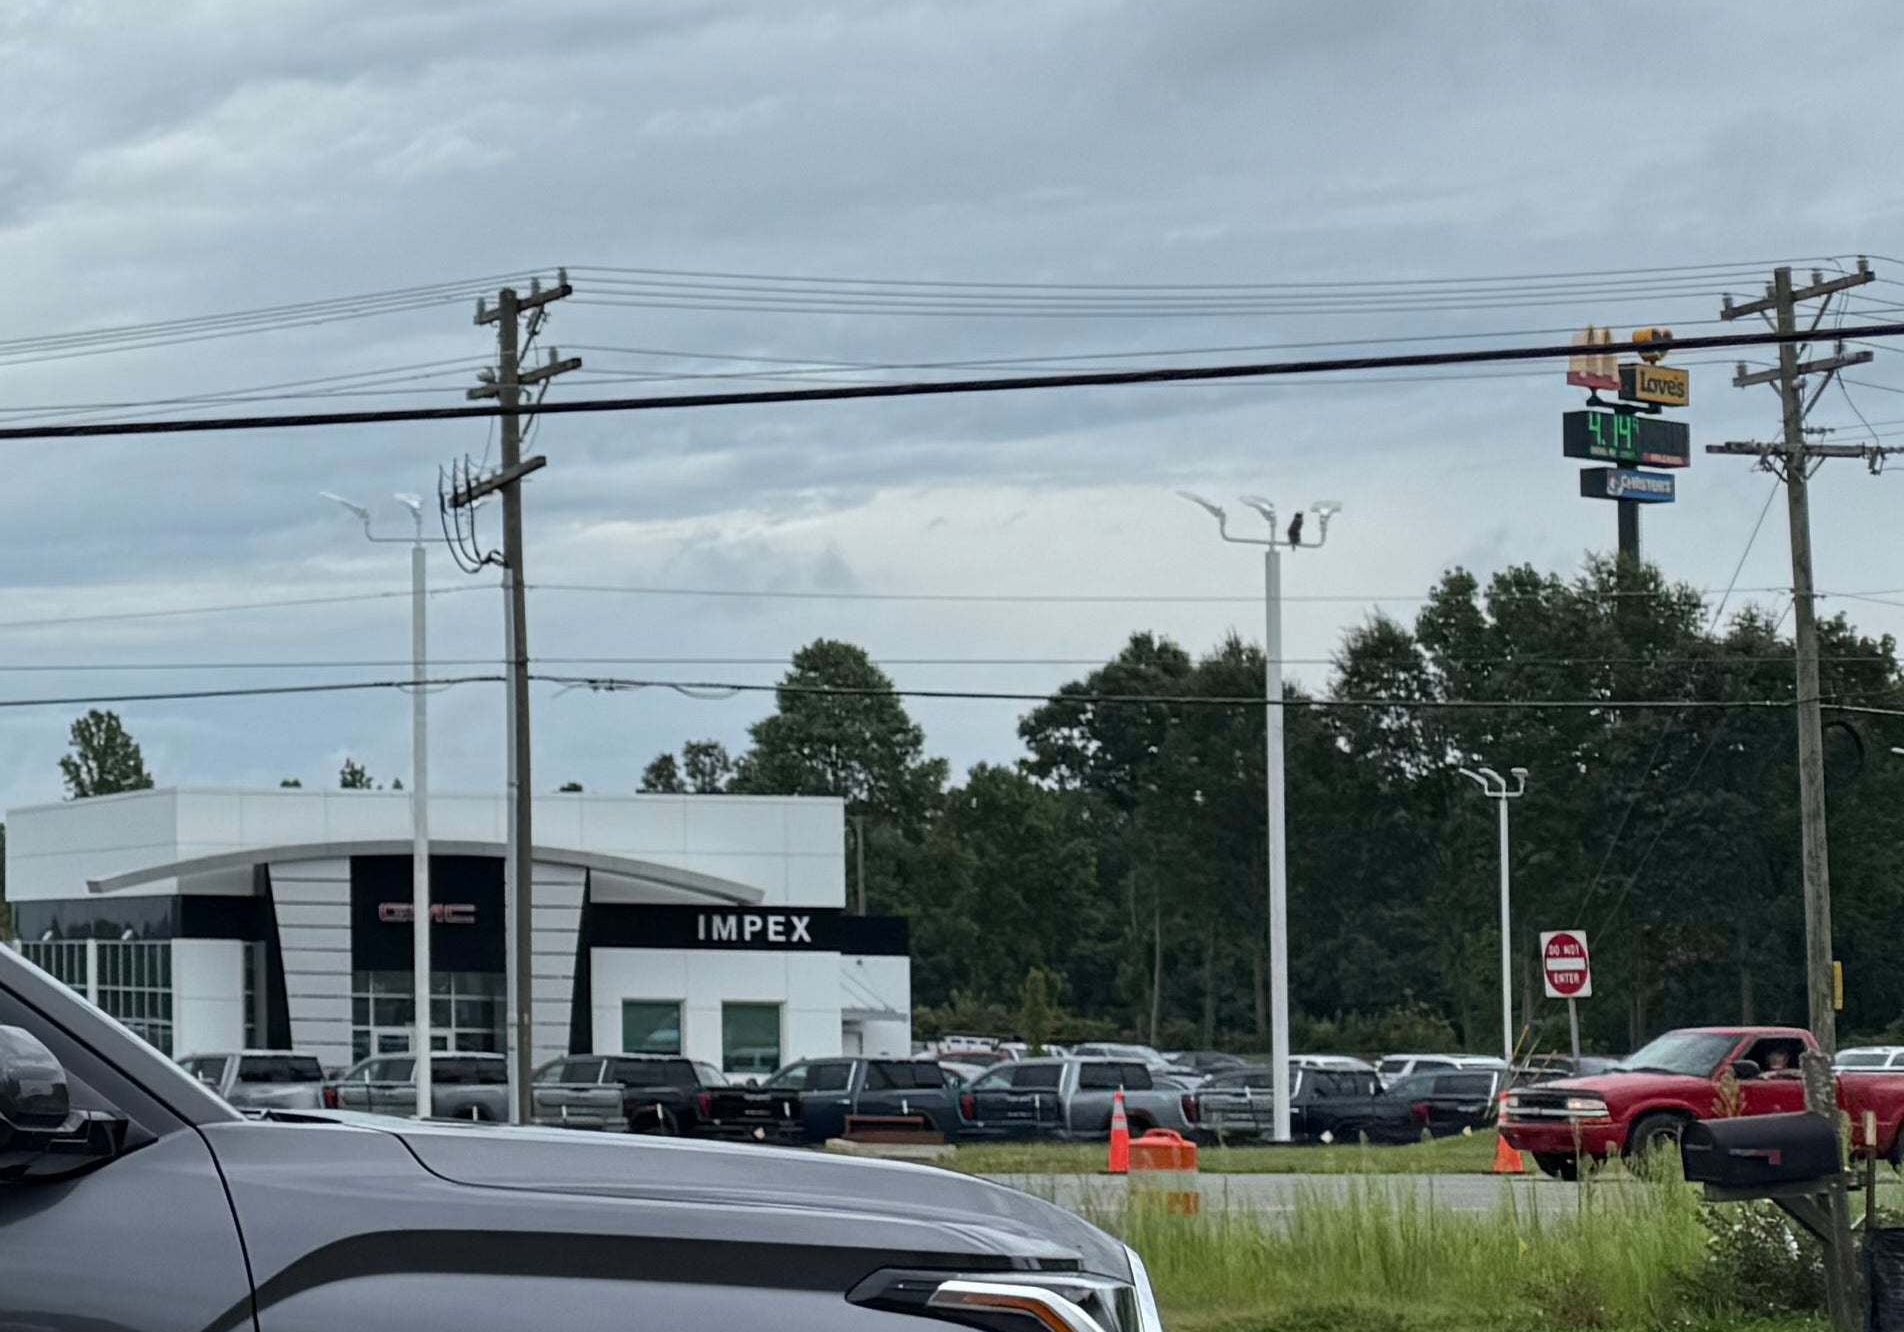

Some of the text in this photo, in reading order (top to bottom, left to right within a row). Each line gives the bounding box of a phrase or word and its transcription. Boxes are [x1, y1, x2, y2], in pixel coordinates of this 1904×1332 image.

[698, 914, 812, 942] IMPEX
[1549, 943, 1580, 956] DO NOT
